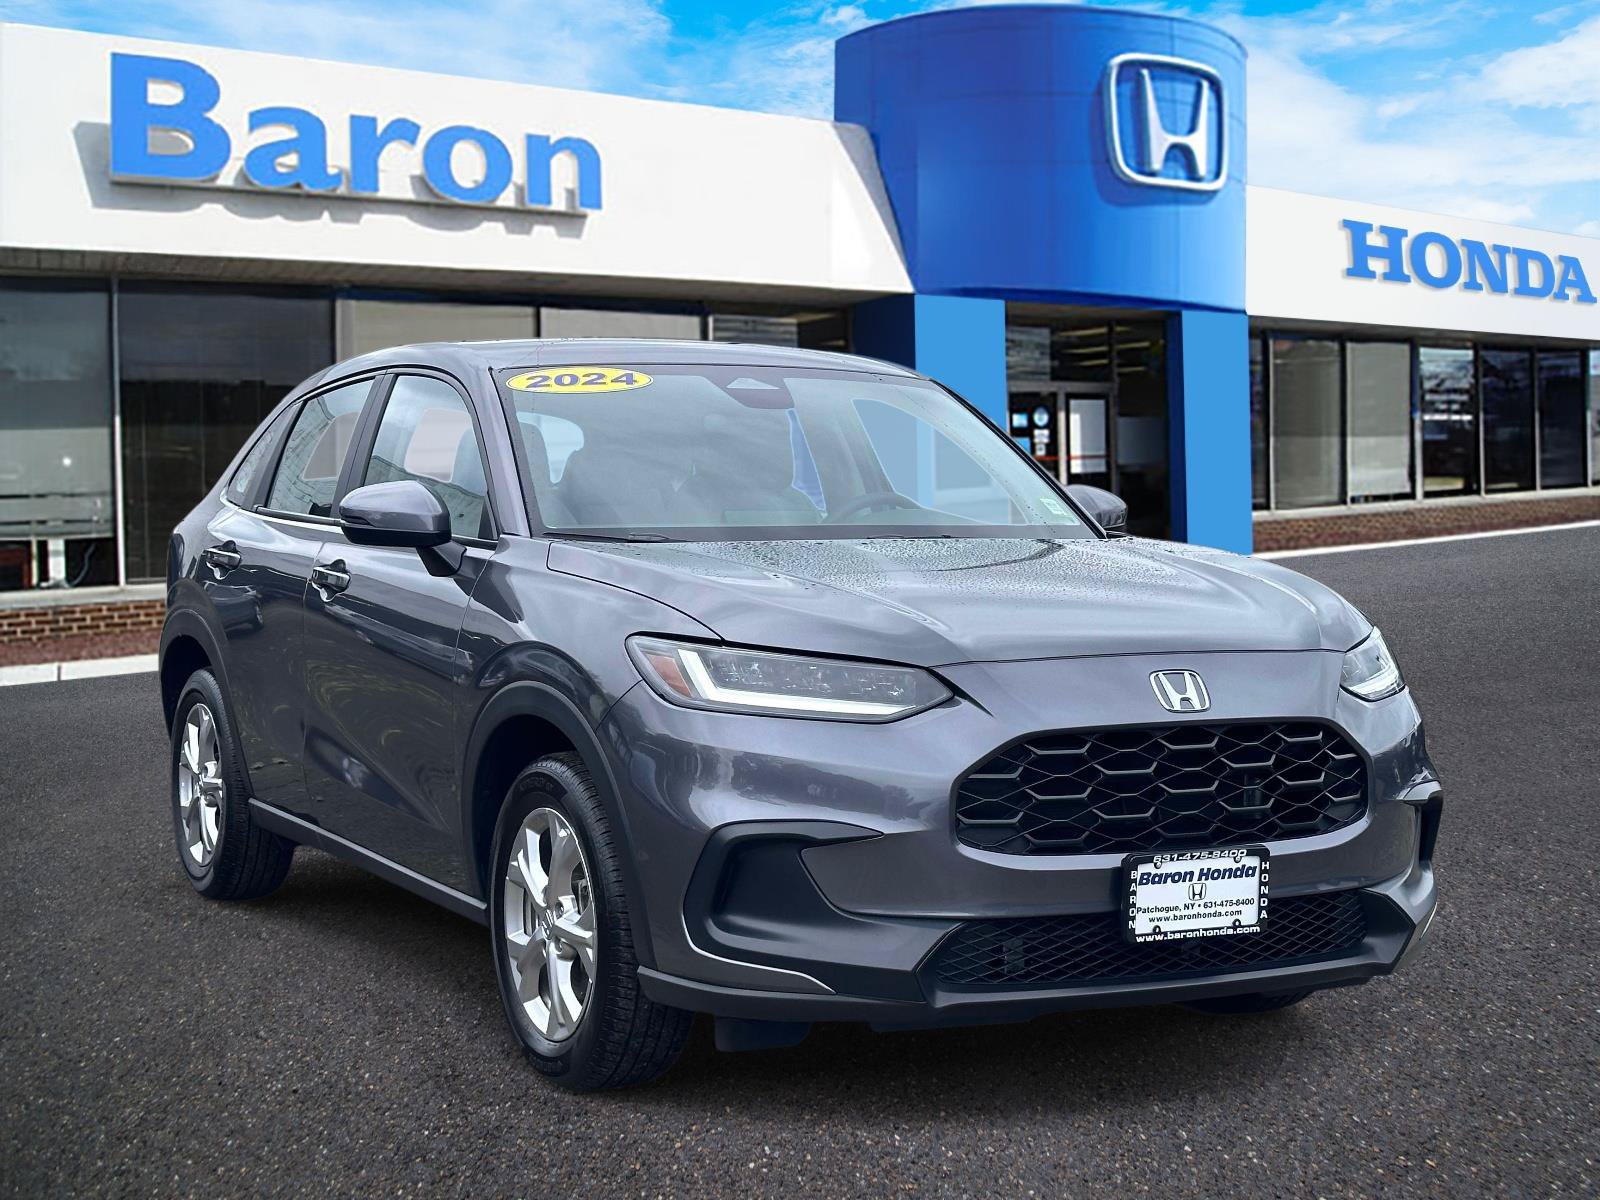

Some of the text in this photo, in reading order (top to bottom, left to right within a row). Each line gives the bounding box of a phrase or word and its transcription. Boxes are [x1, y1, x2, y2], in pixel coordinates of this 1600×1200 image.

[110, 52, 602, 211] Baron
[1342, 218, 1598, 304] HONDA
[526, 372, 638, 389] 2024
[1138, 864, 1257, 886] Baron Honda
[1128, 870, 1137, 930] BARON
[1260, 861, 1270, 920] HONDA
[1136, 897, 1255, 915] Patchogue, NY 631-475-8400
[1149, 909, 1242, 922] www.baronhonda.com
[1136, 925, 1260, 943] www.baronhonda.com
